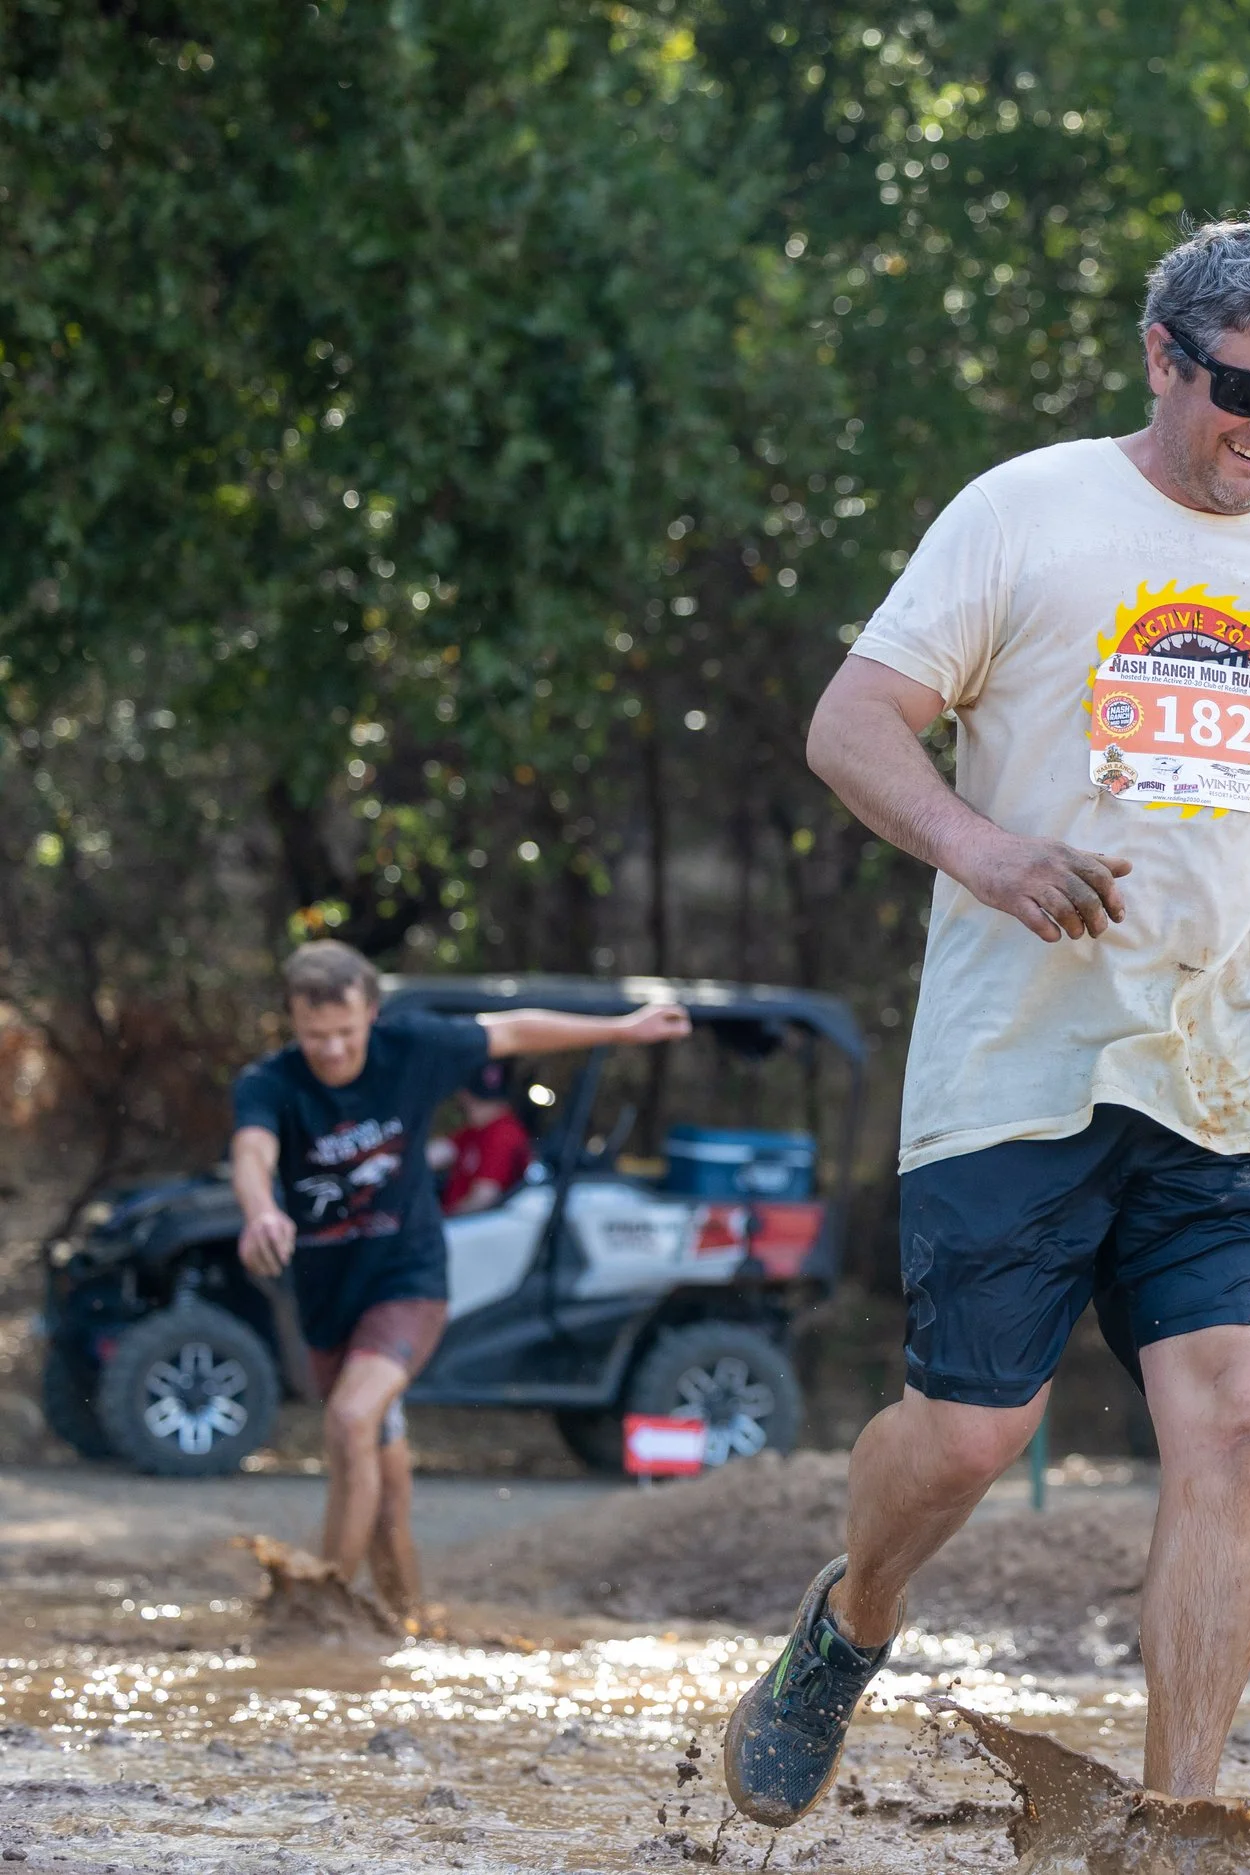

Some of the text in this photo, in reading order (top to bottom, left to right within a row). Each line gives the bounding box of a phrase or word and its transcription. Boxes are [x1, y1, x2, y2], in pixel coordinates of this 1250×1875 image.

[1133, 611, 1203, 652] ACTIVE
[1112, 658, 1147, 675] NASH
[1152, 661, 1195, 680] RANCH
[1200, 666, 1227, 684] MUD
[1120, 673, 1142, 681] hosted
[1151, 675, 1162, 683] the
[1163, 677, 1183, 685] Active
[1183, 679, 1203, 687] 20-30
[1203, 681, 1217, 690] Club
[1224, 685, 1248, 695] Redding
[1110, 705, 1130, 714] NASH
[1109, 712, 1130, 721] RANCH
[1096, 763, 1136, 776] NASH RANCH
[1137, 781, 1166, 792] PURSUIT
